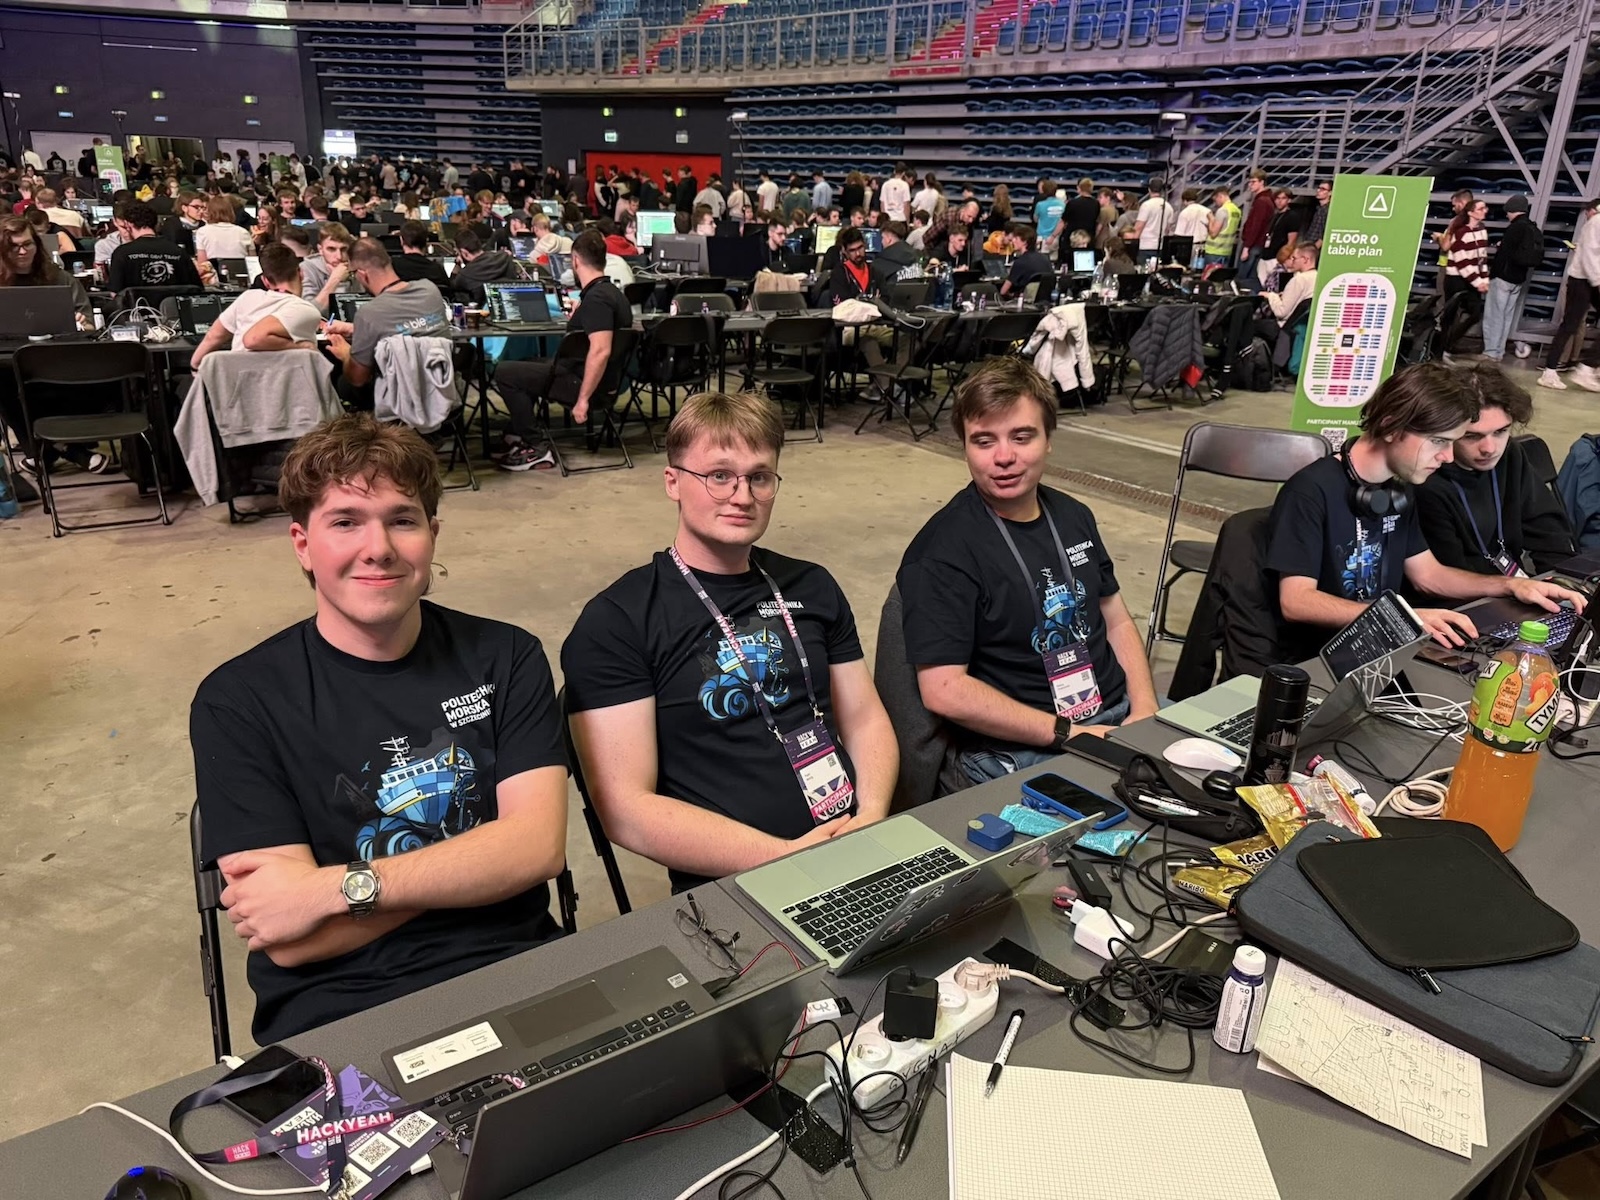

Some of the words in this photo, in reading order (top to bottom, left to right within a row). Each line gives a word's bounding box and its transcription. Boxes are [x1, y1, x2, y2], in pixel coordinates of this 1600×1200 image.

[1329, 233, 1369, 245] FLOOR
[1327, 244, 1357, 256] table
[1358, 245, 1383, 258] plan
[1306, 418, 1341, 426] PARTICIPANT
[715, 614, 748, 662] HACKYEAH
[445, 698, 491, 723] MORSKA
[449, 721, 458, 729] W
[814, 785, 850, 815] PARTICIPANT
[1179, 880, 1206, 895] HARIBO
[296, 1111, 391, 1144] HACKYEAH
[232, 1143, 250, 1155] HACK
